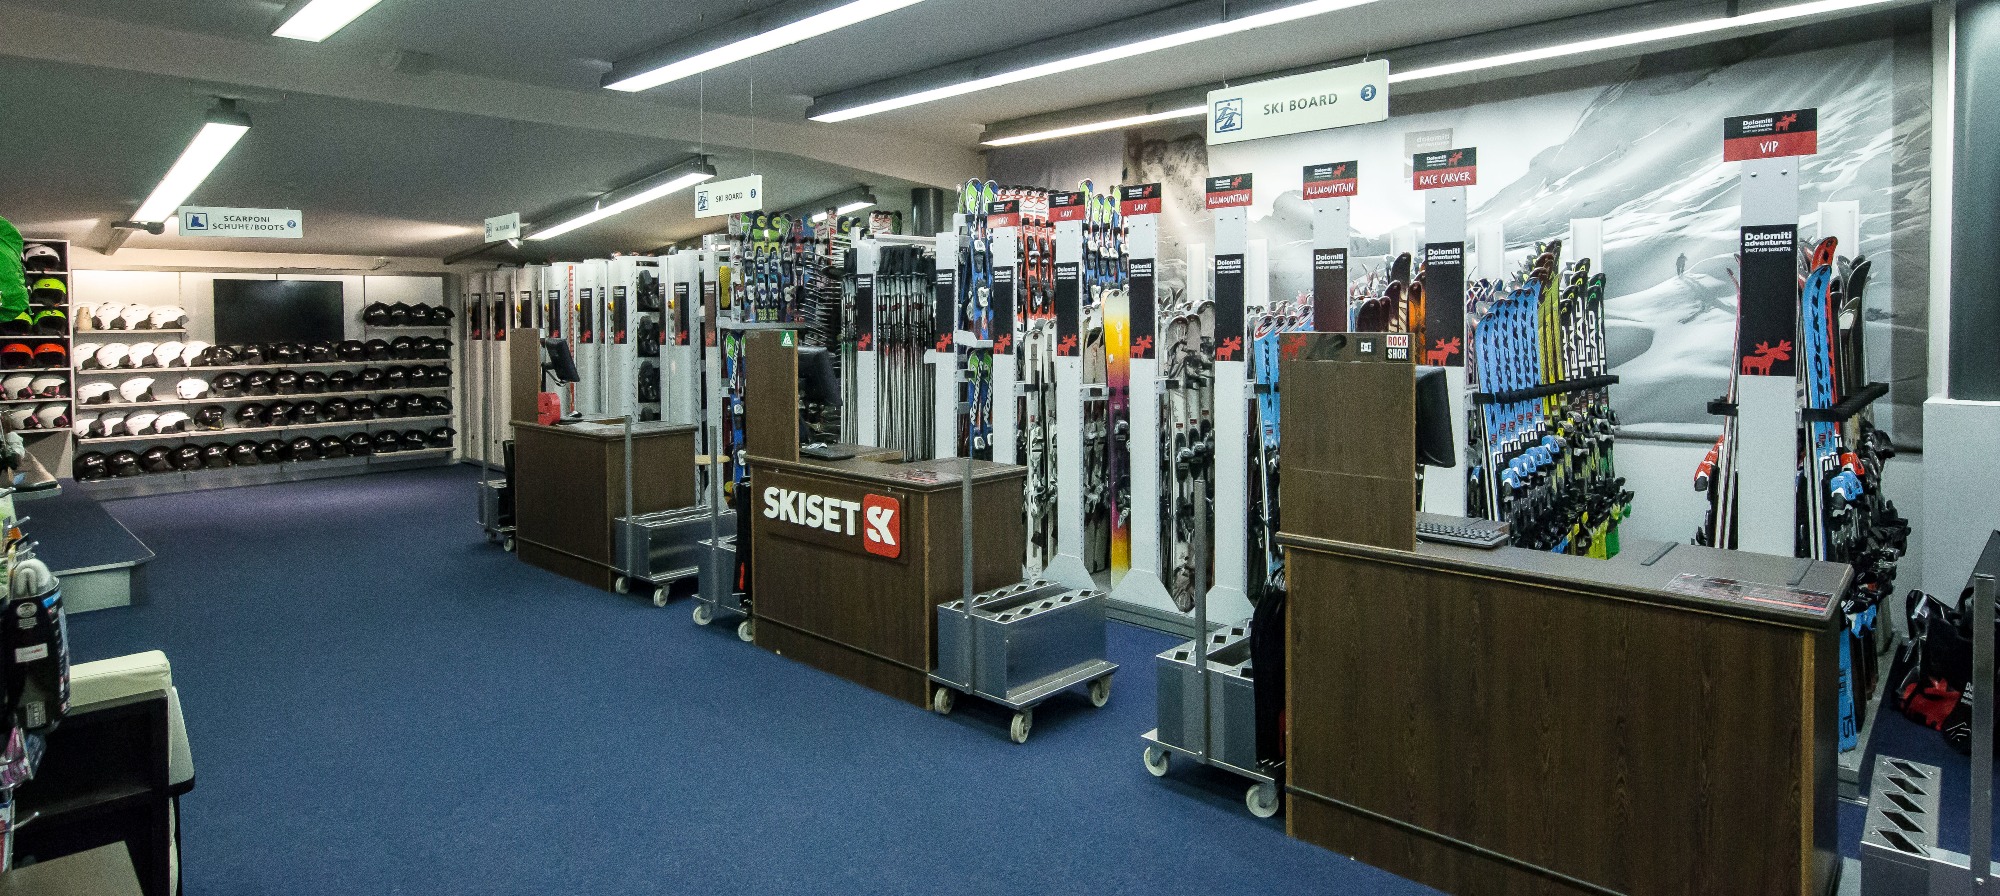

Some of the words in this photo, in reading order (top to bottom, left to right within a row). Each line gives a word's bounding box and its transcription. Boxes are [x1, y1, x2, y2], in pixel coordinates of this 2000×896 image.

[1263, 102, 1284, 116] SKI
[1289, 93, 1338, 112] BOARD
[1364, 86, 1372, 99] 3
[1742, 117, 1773, 126] Dolomiti
[1759, 140, 1779, 154] VIP
[1419, 174, 1438, 186] RACE
[1440, 171, 1471, 184] CARVER
[1306, 182, 1354, 196] ALLMOUNTAIN
[1208, 193, 1250, 205] ALLMOUNTAIN
[223, 215, 271, 223] SCARPONI
[212, 222, 285, 231] SCHUHE/BOOTS
[1744, 231, 1792, 240] Dolomiti
[1744, 239, 1792, 247] adventures
[1315, 253, 1344, 261] Dolomiti
[1427, 247, 1460, 256] Dolomiti
[1387, 335, 1407, 347] ROCK
[1387, 348, 1407, 360] SHOX
[763, 486, 861, 536] SKISET
